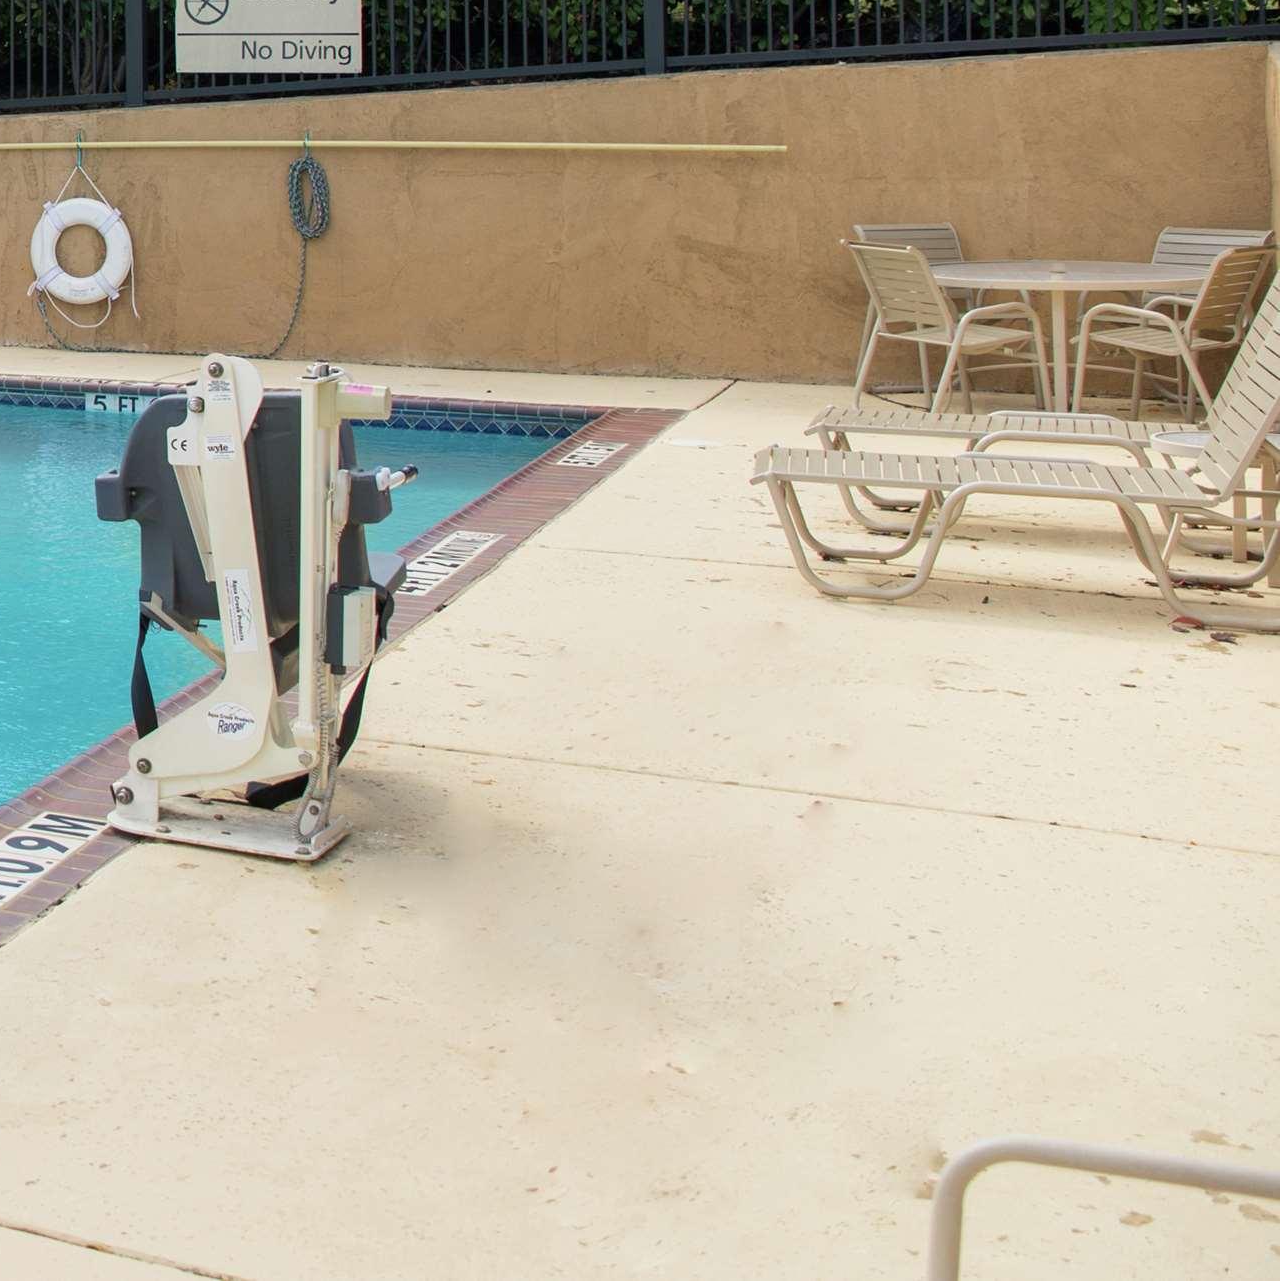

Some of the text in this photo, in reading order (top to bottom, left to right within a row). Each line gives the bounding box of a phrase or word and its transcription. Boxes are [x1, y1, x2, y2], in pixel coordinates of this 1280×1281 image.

[241, 40, 352, 65] No Diving
[93, 395, 139, 413] 5 FT
[27, 813, 109, 839] M
